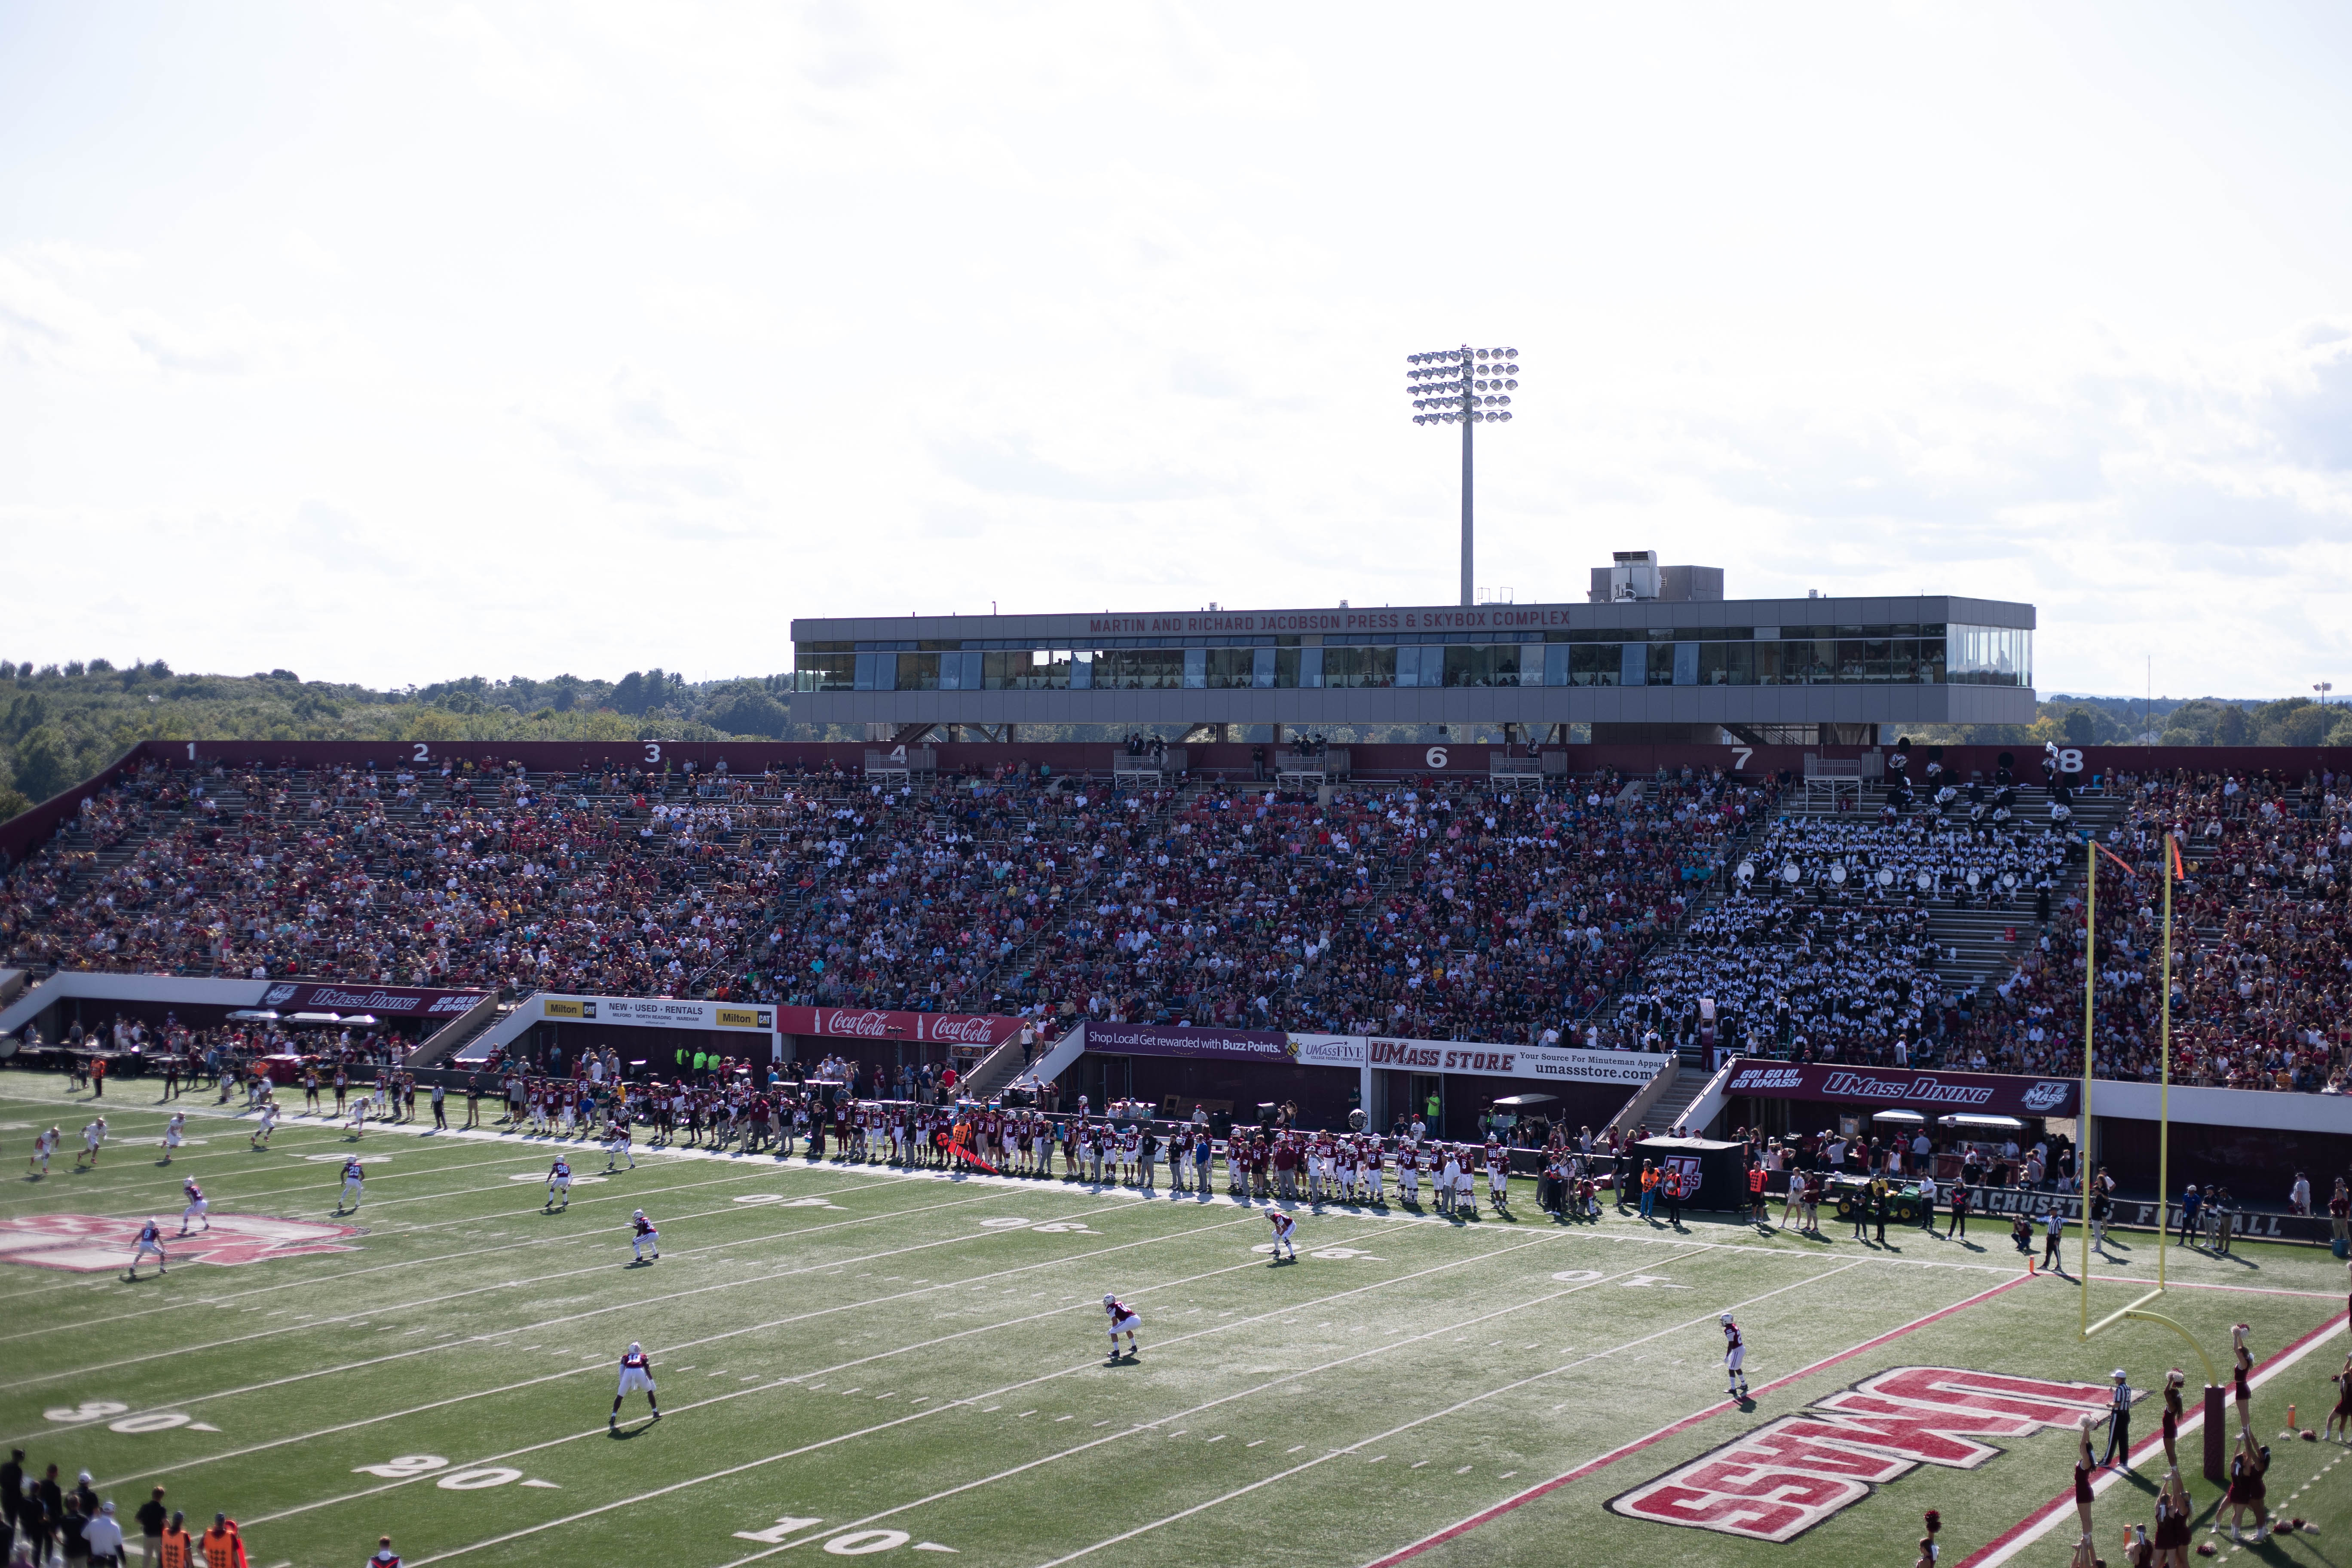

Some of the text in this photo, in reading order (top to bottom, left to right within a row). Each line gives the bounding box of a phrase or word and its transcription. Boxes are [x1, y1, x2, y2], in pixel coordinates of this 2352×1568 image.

[1090, 611, 1569, 632] MARTIN AND RICHARD JACOBSON PRESS & SKYBOX COMPLEX
[187, 743, 195, 760] 1
[413, 743, 429, 761] 2
[644, 744, 661, 763] 3
[891, 745, 906, 763] 4
[1426, 747, 1448, 768] 6
[1731, 747, 1753, 769] 7
[2060, 749, 2083, 772] 8
[551, 1004, 577, 1014] Milton
[584, 1006, 596, 1015] CAT
[635, 1004, 658, 1012] USED
[665, 1006, 703, 1015] RENTALS
[723, 1013, 751, 1023] Milton
[759, 1014, 771, 1024] CAT
[828, 1010, 889, 1036] Coca-Cola
[932, 1016, 995, 1042] Coca-Cola
[1089, 1032, 1281, 1053] Shop Local! Get rewarded with Buzz Points.
[1444, 1050, 1516, 1072] STORE
[1541, 1053, 1569, 1061] Source
[1588, 1056, 1635, 1066] Minuteman
[1535, 1064, 1653, 1080] umassstore.com
[1740, 1069, 1799, 1079] GO! GO U!
[579, 1083, 588, 1091] 55
[1730, 1078, 1803, 1088] GO UMASS!
[1964, 1121, 2015, 1129] CONCESSIONS
[349, 1167, 359, 1177] 29
[557, 1164, 568, 1174] 98
[144, 1229, 151, 1239] 8
[42, 1401, 191, 1434] 30
[351, 1455, 523, 1491] 20
[731, 1516, 911, 1556] 10
